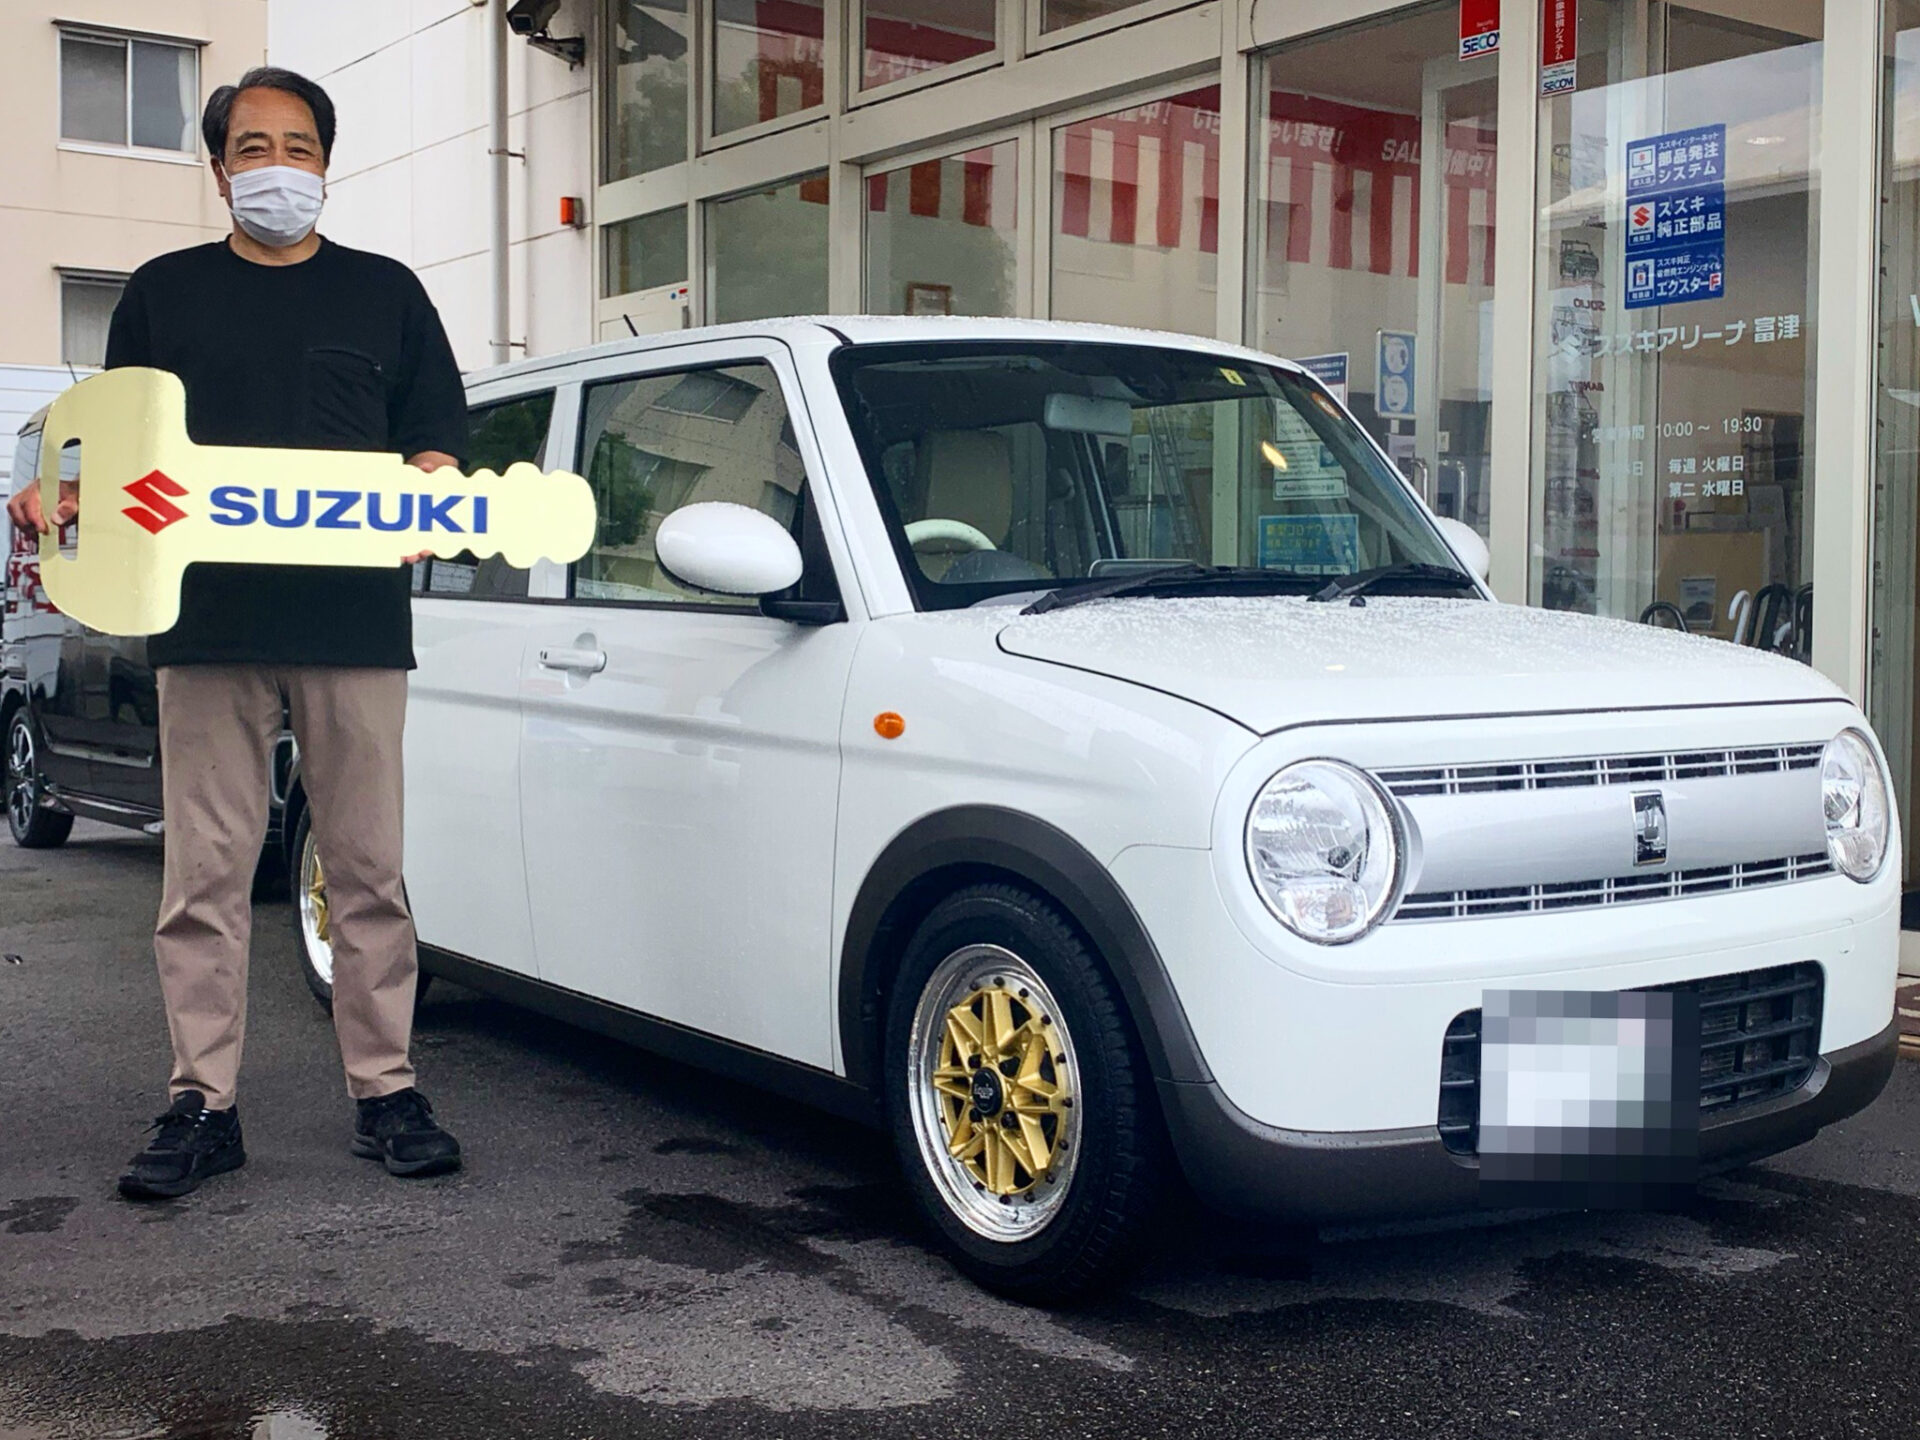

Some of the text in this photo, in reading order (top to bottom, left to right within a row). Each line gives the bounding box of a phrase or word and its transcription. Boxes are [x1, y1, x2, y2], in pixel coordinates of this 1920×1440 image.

[1463, 32, 1499, 54] SECO
[1543, 77, 1574, 92] SECOM
[1382, 138, 1421, 164] SAL
[1658, 142, 1719, 167] 部品発注
[1659, 161, 1717, 184] システム
[1658, 195, 1705, 218] スズキ
[1657, 212, 1722, 238] 純正部品
[1592, 314, 1799, 358] スズキアリーナ 富津
[1656, 421, 1693, 438] 10:00
[1722, 416, 1762, 434] 19:30
[1668, 455, 1744, 474] 毎週 火曜日
[1668, 479, 1744, 498] 第二 水曜日
[209, 485, 488, 534] SUZUKI
